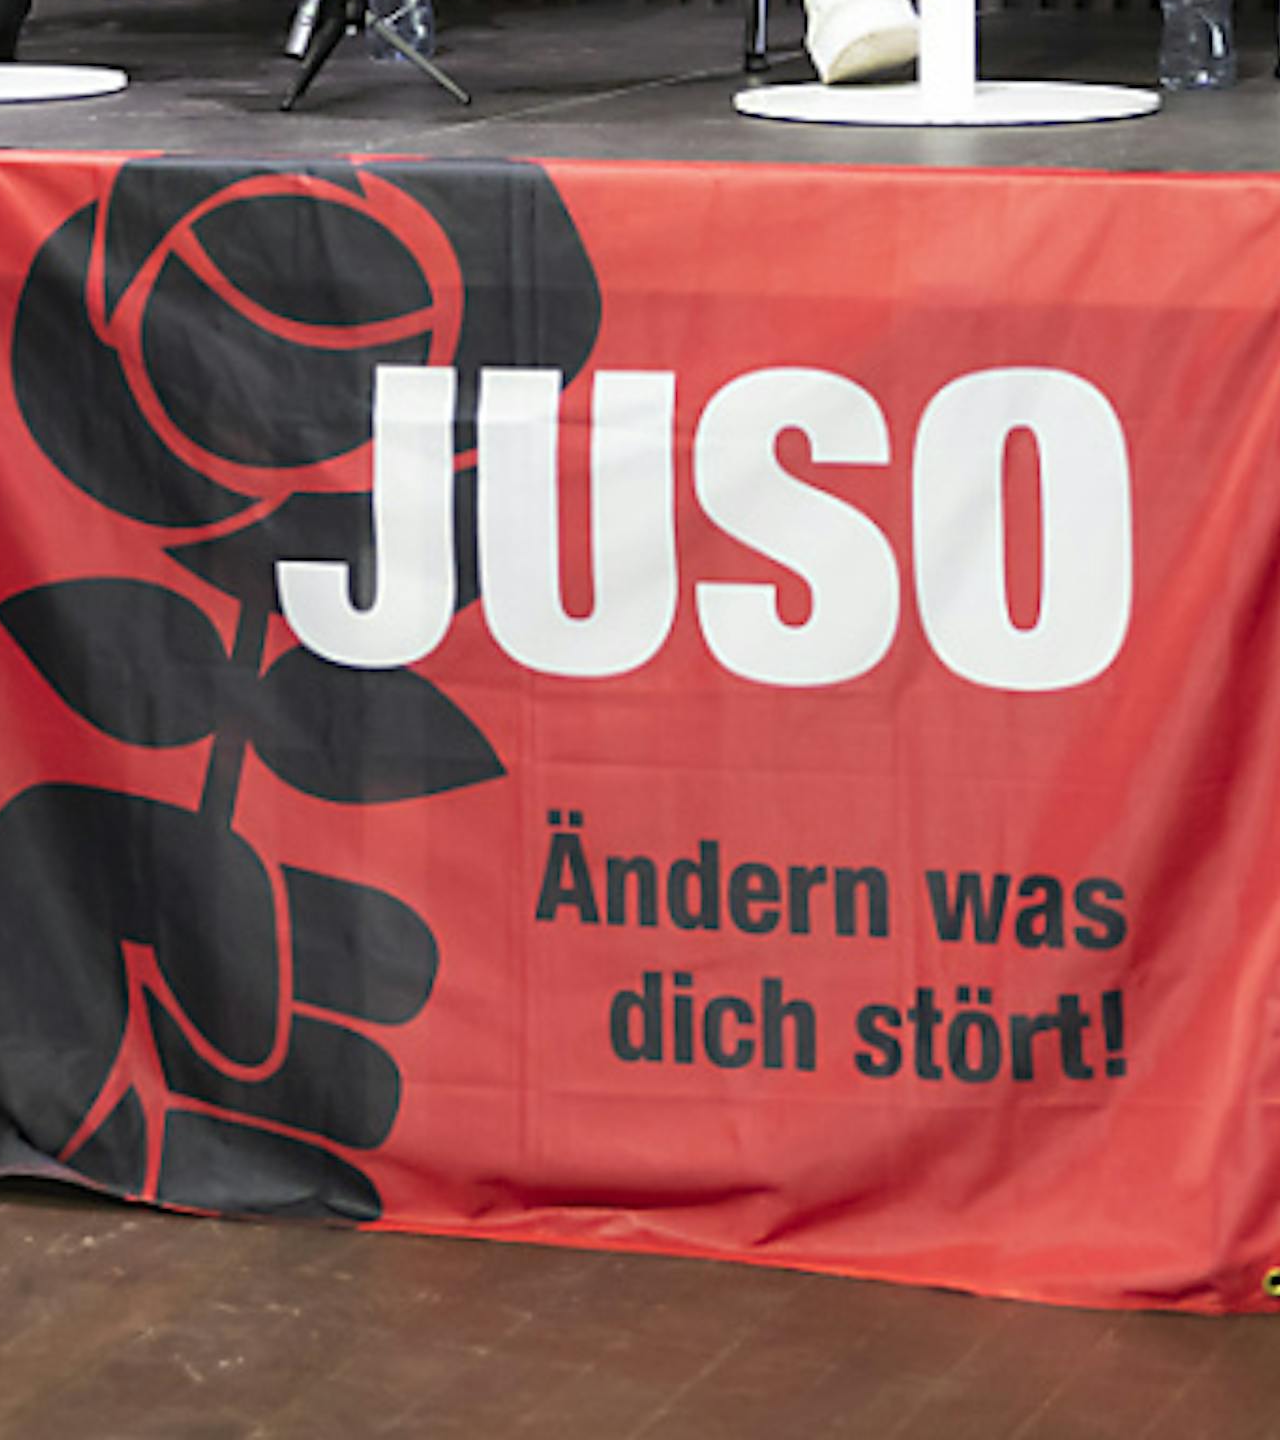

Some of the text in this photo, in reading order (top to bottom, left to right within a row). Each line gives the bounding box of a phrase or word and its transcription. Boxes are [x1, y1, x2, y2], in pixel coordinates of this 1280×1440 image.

[276, 364, 1133, 692] JUSO
[534, 808, 1129, 952] Ändern was
[609, 970, 1128, 1085] dich stört!
